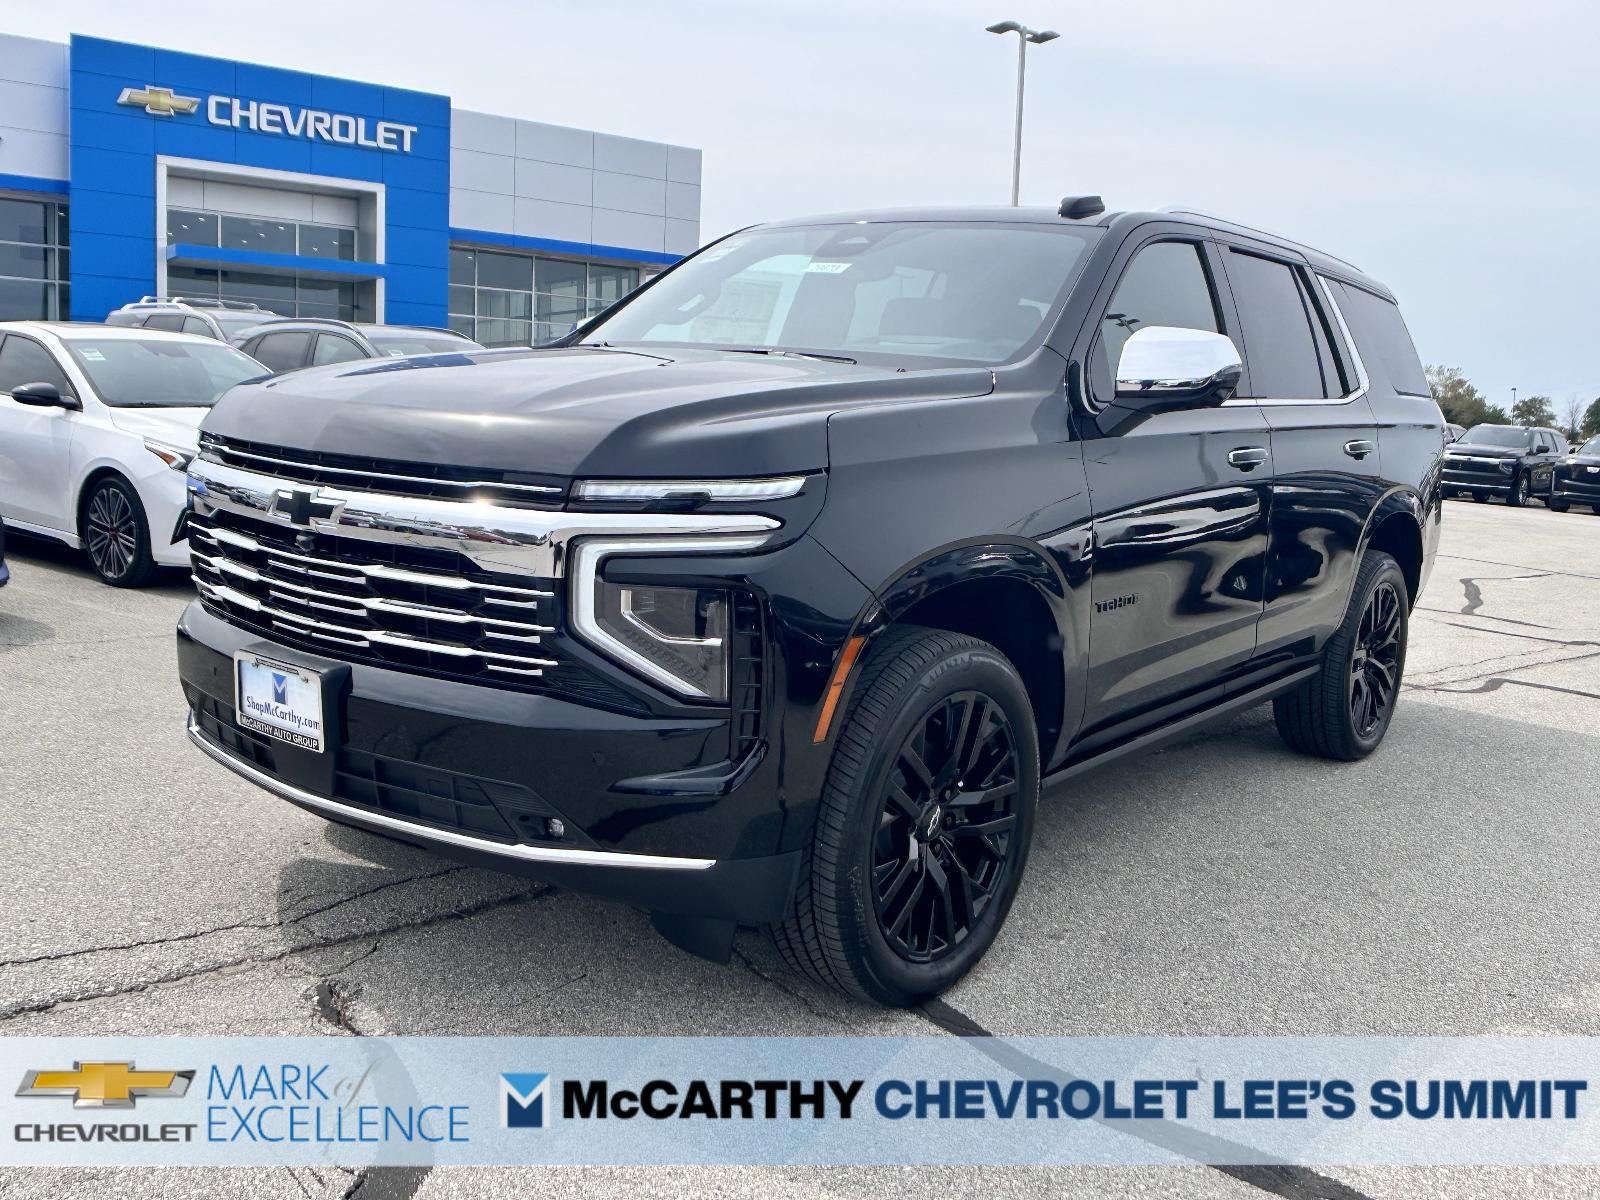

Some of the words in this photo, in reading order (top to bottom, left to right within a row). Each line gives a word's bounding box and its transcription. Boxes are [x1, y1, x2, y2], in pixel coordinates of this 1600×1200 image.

[207, 95, 417, 152] CHEVROLET
[246, 695, 320, 729] ShopMcCarthy.com
[273, 728, 291, 740] AUTO
[292, 734, 318, 748] GROUP
